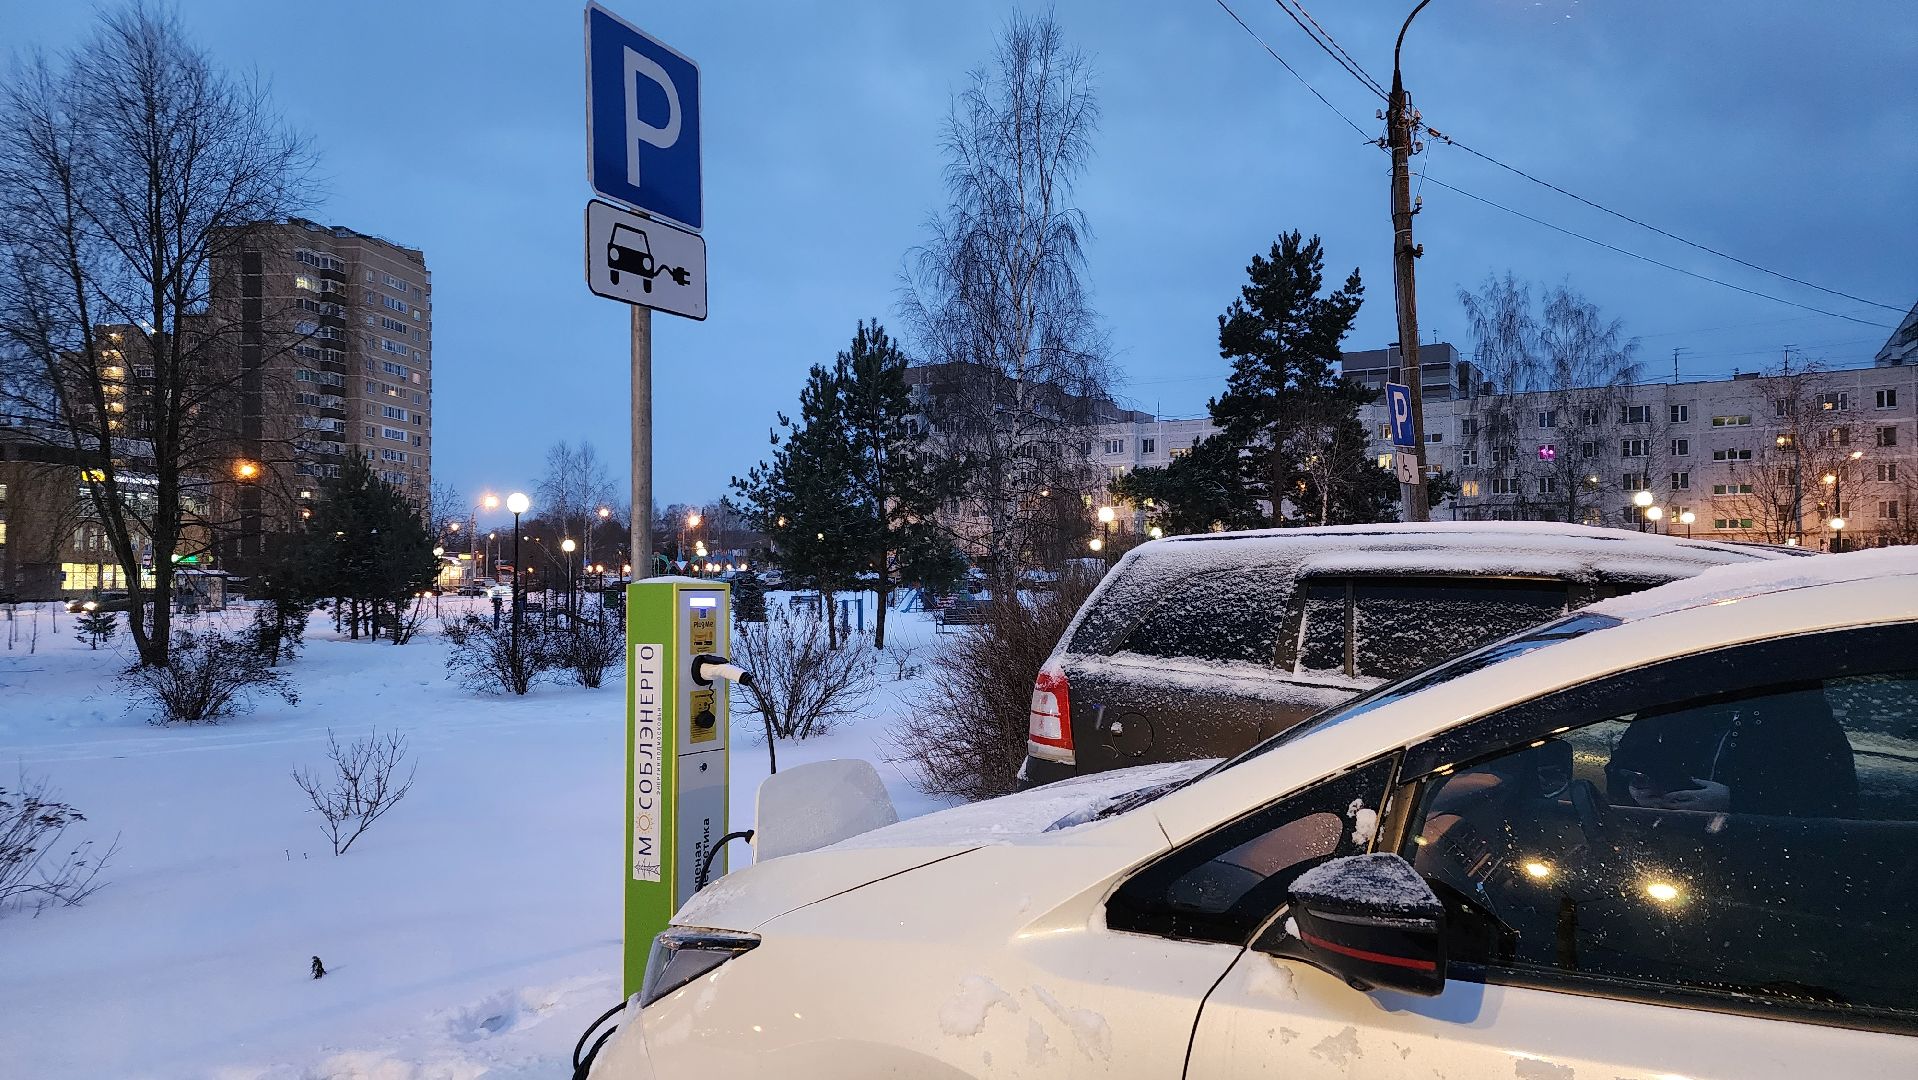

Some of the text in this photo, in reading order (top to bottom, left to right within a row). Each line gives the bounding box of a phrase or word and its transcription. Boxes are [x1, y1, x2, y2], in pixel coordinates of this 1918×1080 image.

[623, 45, 682, 187] P
[1393, 391, 1408, 439] P
[638, 645, 655, 856] МОСОБЛЭНЕРГО
